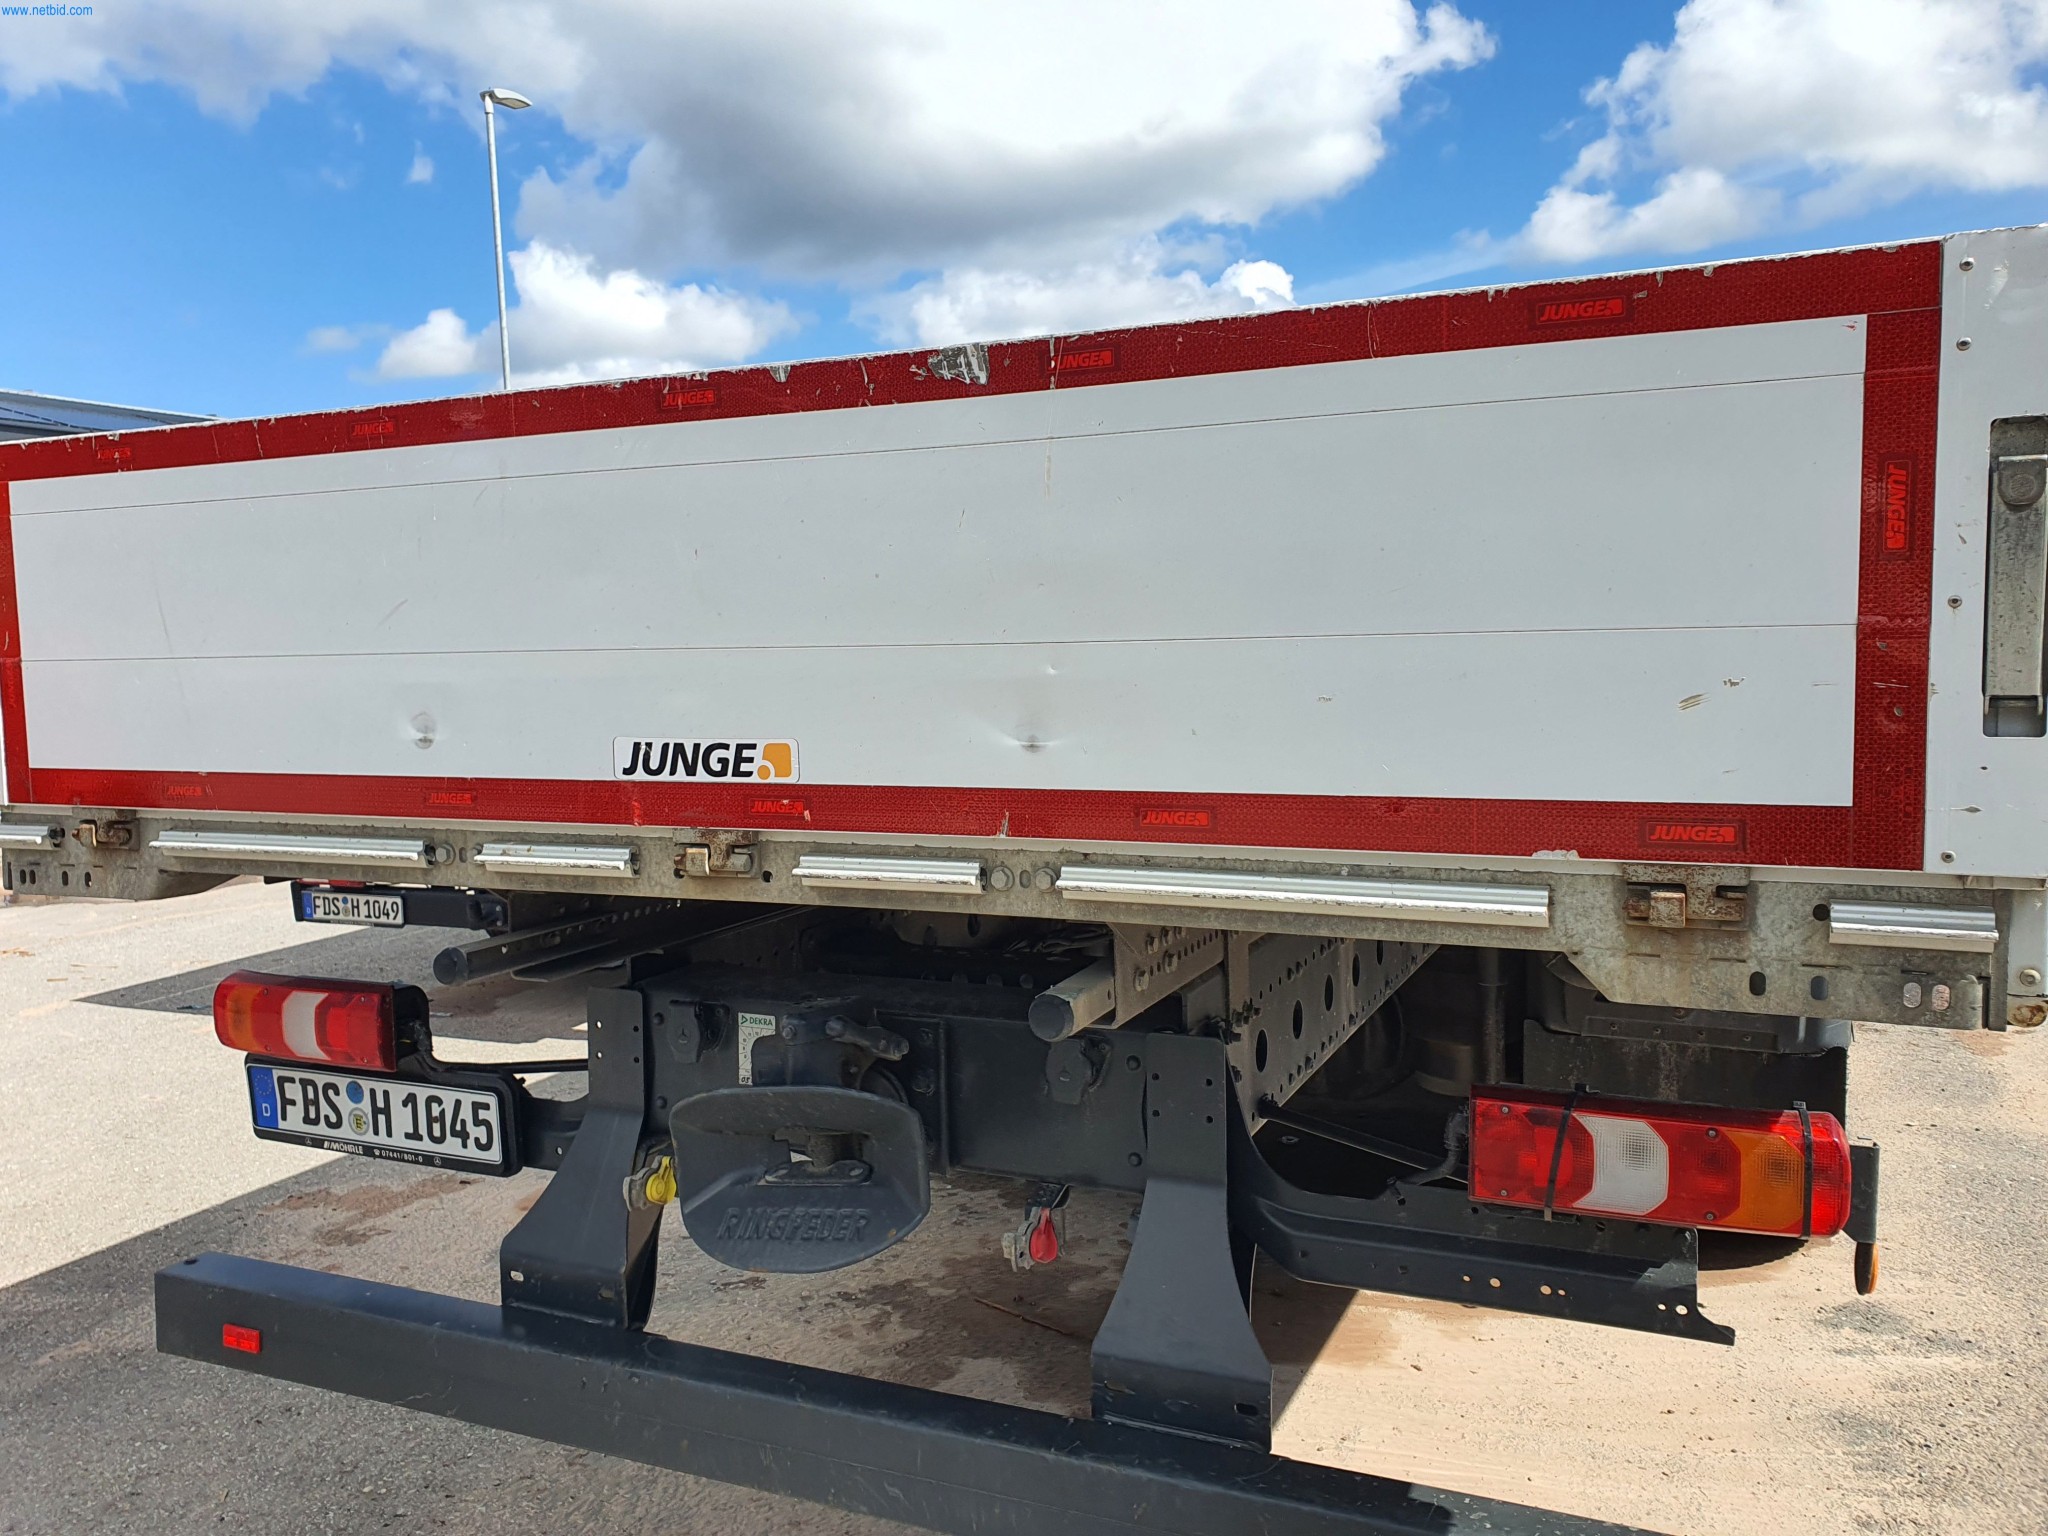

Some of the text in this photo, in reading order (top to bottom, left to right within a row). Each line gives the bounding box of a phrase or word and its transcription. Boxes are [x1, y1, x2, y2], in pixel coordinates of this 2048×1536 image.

[1540, 301, 1607, 321] JUNGE
[1887, 464, 1907, 533] JUNGE
[622, 741, 758, 778] JUNGE
[429, 792, 465, 804] JUNGE
[751, 800, 794, 813] JUNGE
[1143, 810, 1196, 825] JUNGE
[1650, 825, 1718, 842] JUNGE
[313, 896, 341, 916] FDS
[351, 898, 361, 918] H
[363, 899, 400, 921] 1049
[749, 1016, 773, 1026] DEKRA
[262, 1103, 271, 1117] D
[369, 1087, 393, 1139] H
[401, 1092, 494, 1152] 1045
[717, 1207, 869, 1241] RINGFEDER
